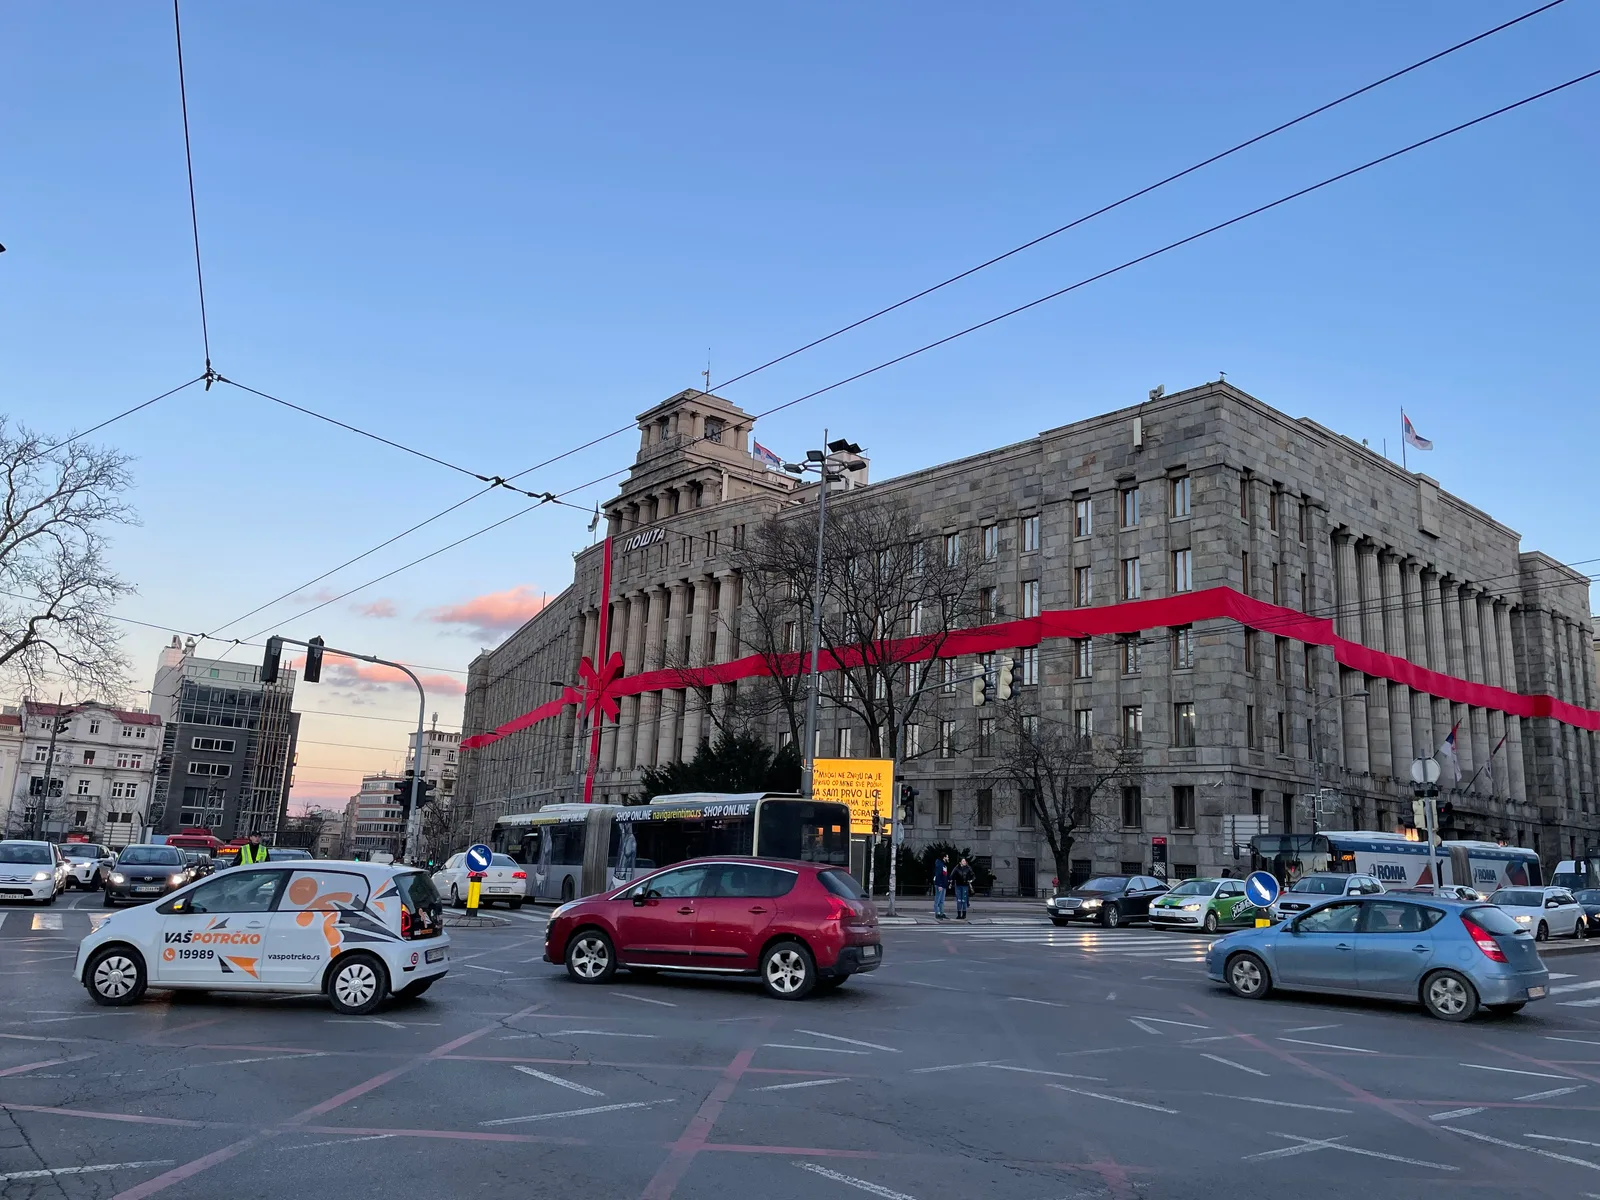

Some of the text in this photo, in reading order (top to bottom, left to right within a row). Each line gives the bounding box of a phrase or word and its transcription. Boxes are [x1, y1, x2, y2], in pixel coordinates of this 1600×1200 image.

[623, 527, 666, 552] ПОШТА
[822, 788, 839, 797] SAM
[840, 789, 863, 799] PRVO
[615, 811, 631, 822] SHOP
[631, 809, 653, 821] ONLINE
[704, 805, 723, 817] SHOP
[723, 803, 751, 816] ONLINE
[1377, 864, 1407, 881] ROMA
[1477, 868, 1497, 881] ROMA
[178, 949, 215, 960] 19989
[267, 953, 320, 961] vaspotrcko.rs
